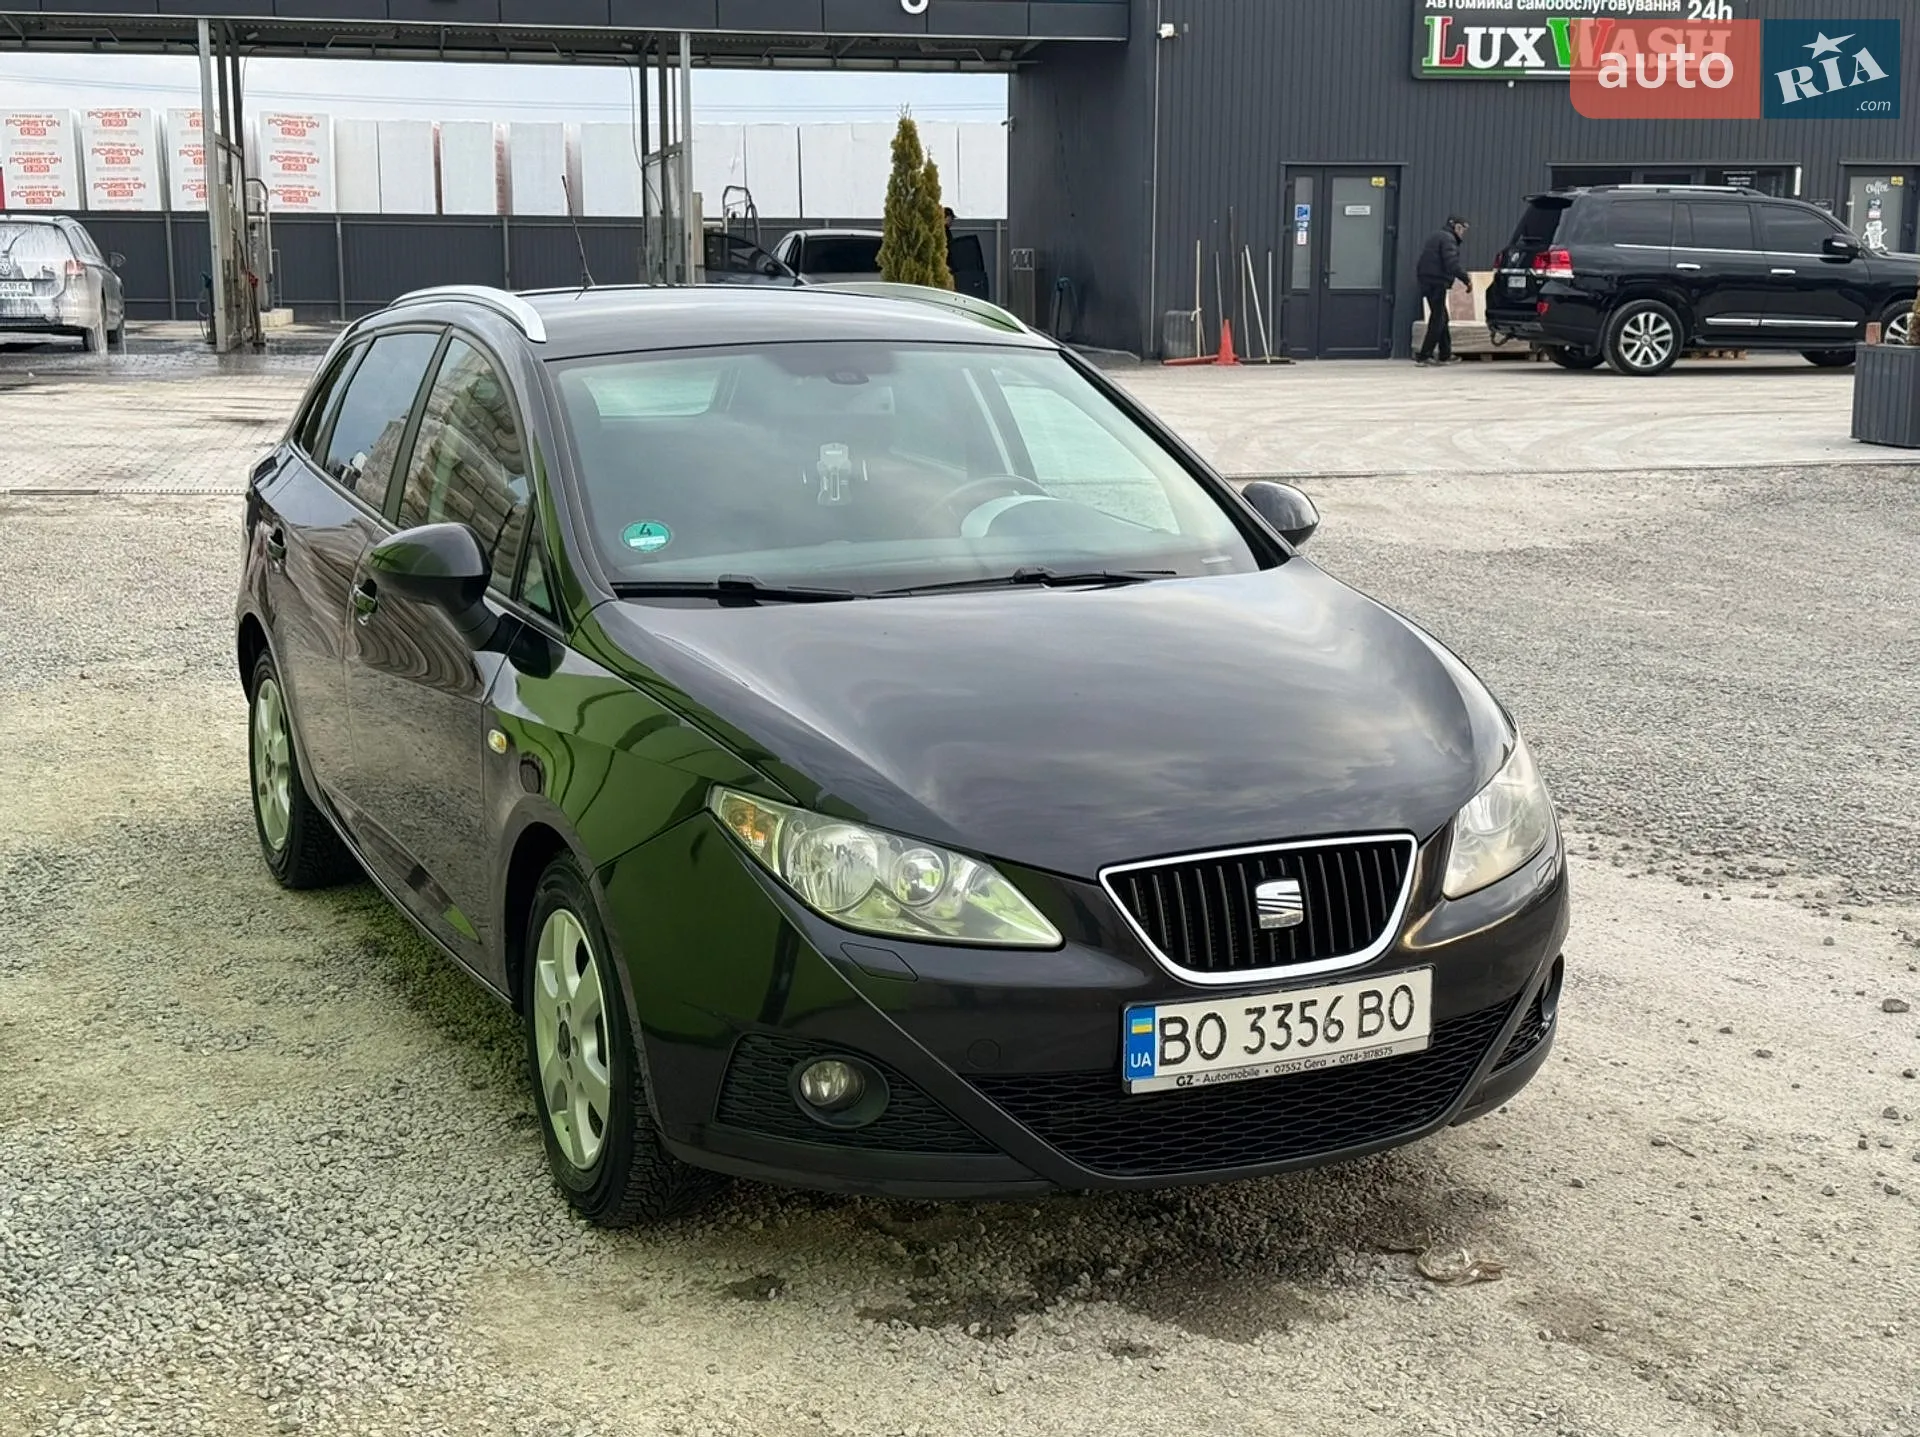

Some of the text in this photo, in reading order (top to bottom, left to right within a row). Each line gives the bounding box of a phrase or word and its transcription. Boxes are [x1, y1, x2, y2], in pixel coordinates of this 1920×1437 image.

[1243, 995, 1344, 1055] 3356
[1130, 1052, 1152, 1068] UA
[1176, 1074, 1194, 1087] GZ
[1203, 1067, 1260, 1083] Automobile
[1273, 1062, 1302, 1073] 07552
